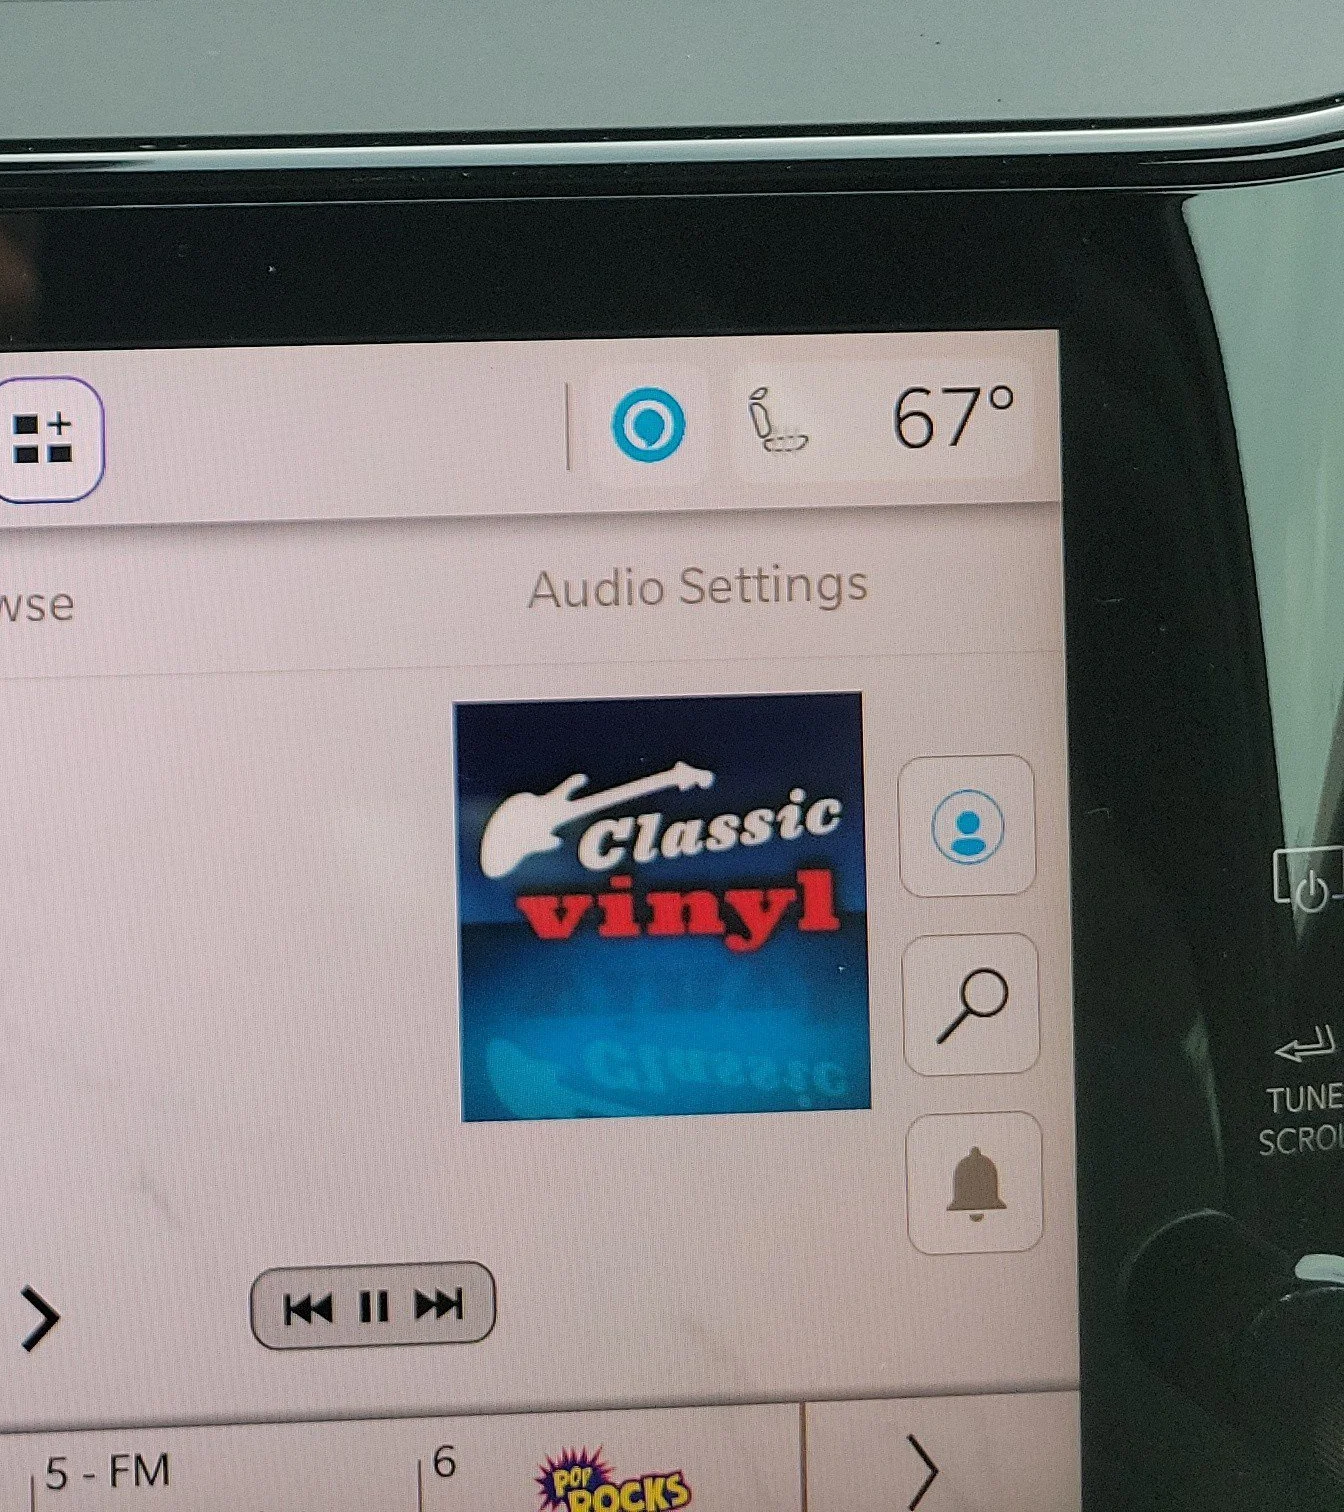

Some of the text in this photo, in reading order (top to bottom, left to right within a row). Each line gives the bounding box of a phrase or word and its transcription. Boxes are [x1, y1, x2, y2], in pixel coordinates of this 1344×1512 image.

[526, 562, 870, 616] Audio Settings
[578, 788, 843, 871] Classic
[516, 868, 840, 954] vinyl
[1265, 1081, 1344, 1114] TUNE
[44, 1454, 69, 1490] 5
[110, 1451, 171, 1488] FM
[433, 1444, 458, 1479] 6
